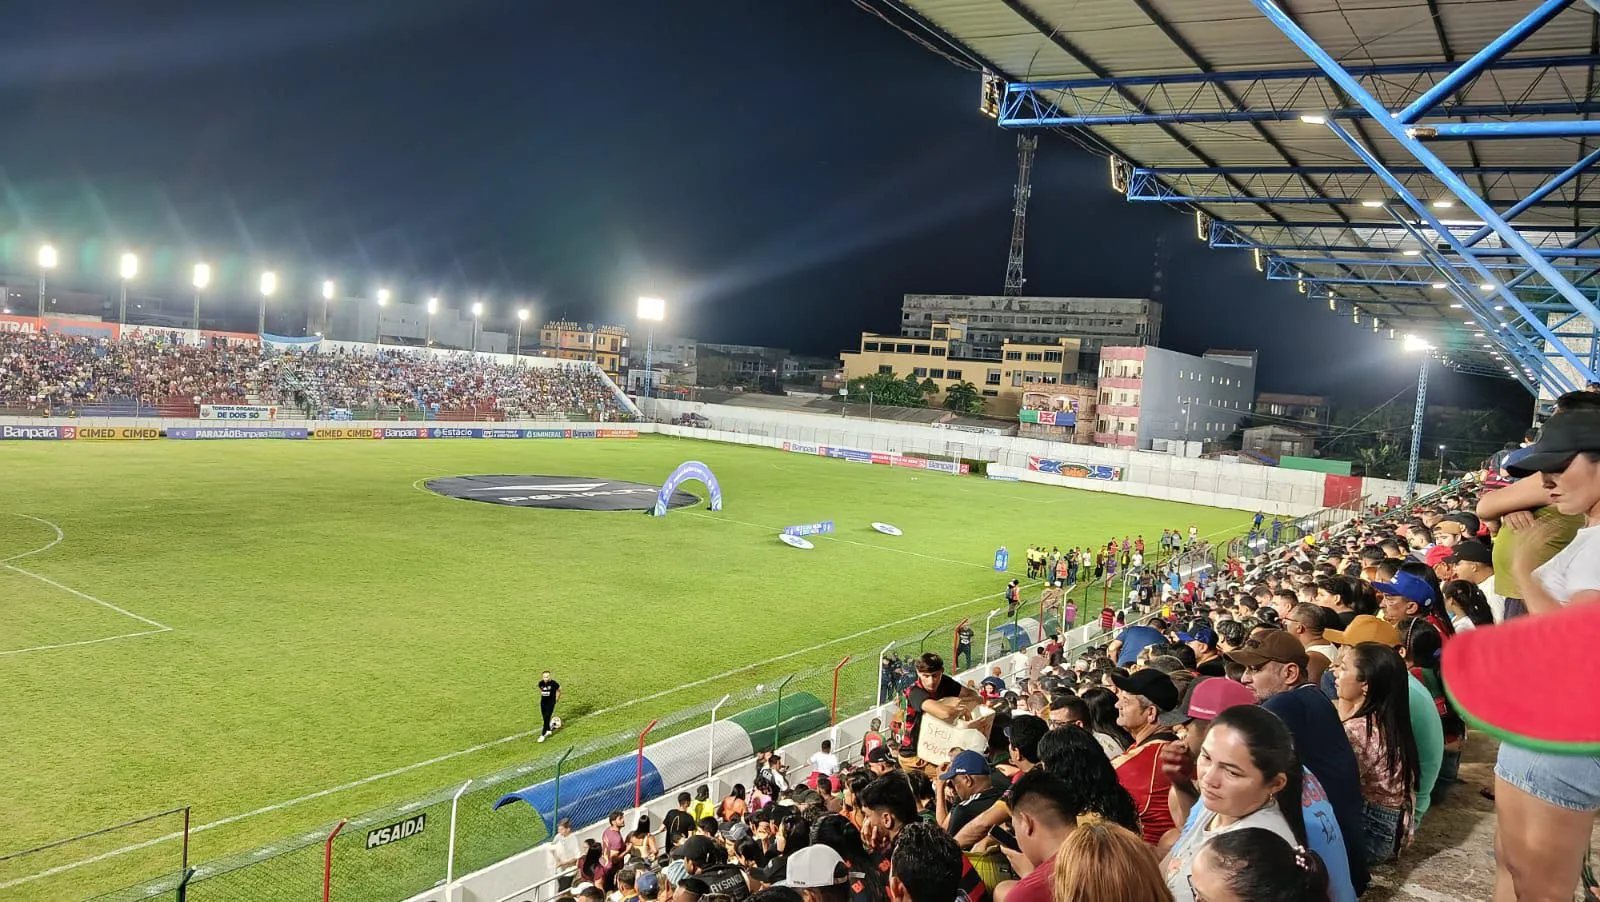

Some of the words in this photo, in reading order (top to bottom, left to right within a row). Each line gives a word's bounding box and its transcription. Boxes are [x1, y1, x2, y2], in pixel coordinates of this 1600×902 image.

[3, 425, 58, 440] Banpará
[79, 429, 116, 438] CIMED
[122, 429, 157, 438] CIMED
[316, 429, 342, 438] CIMED
[347, 429, 372, 438] CIMED
